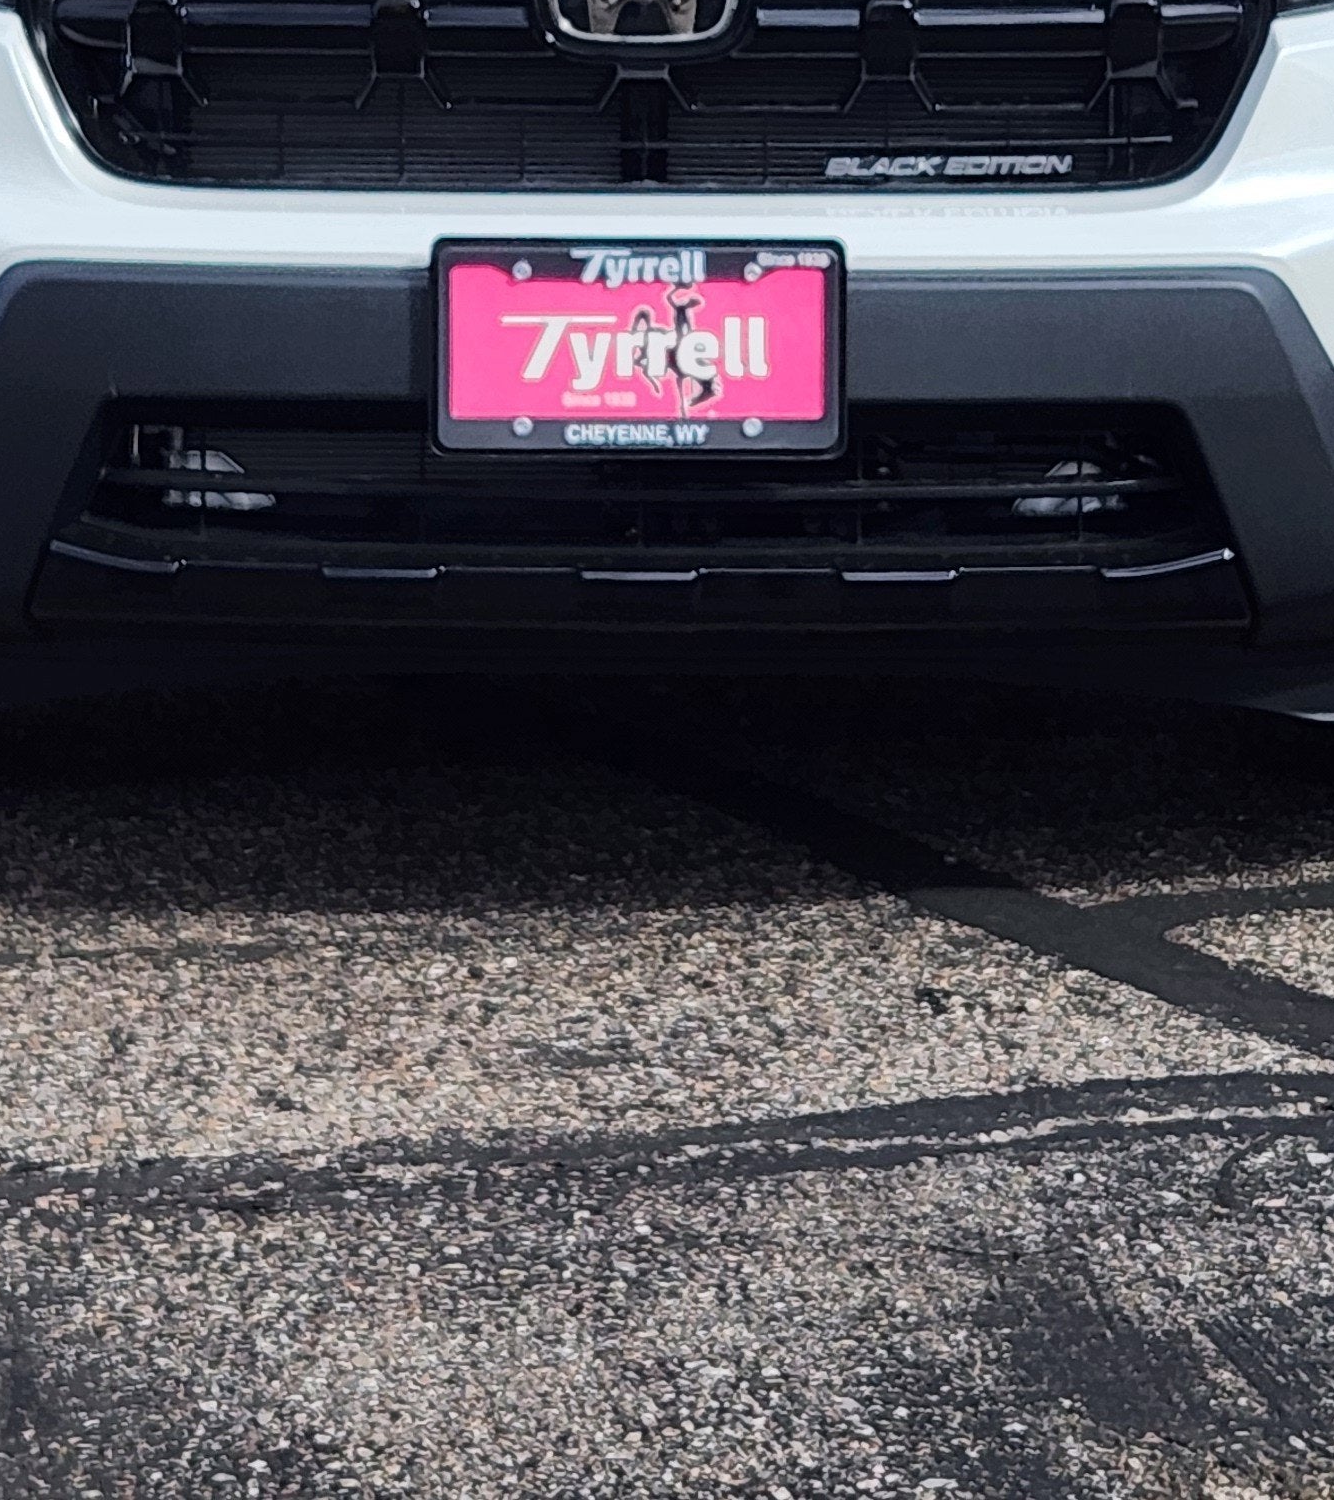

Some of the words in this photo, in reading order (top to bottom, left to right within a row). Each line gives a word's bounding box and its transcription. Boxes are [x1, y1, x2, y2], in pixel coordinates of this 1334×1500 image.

[825, 155, 943, 176] BLACK
[943, 155, 1072, 175] EDITION
[570, 247, 706, 288] Tyrrell
[500, 315, 768, 391] Tyrrell
[564, 423, 673, 446] CHEYENNE,
[674, 423, 709, 445] WY
